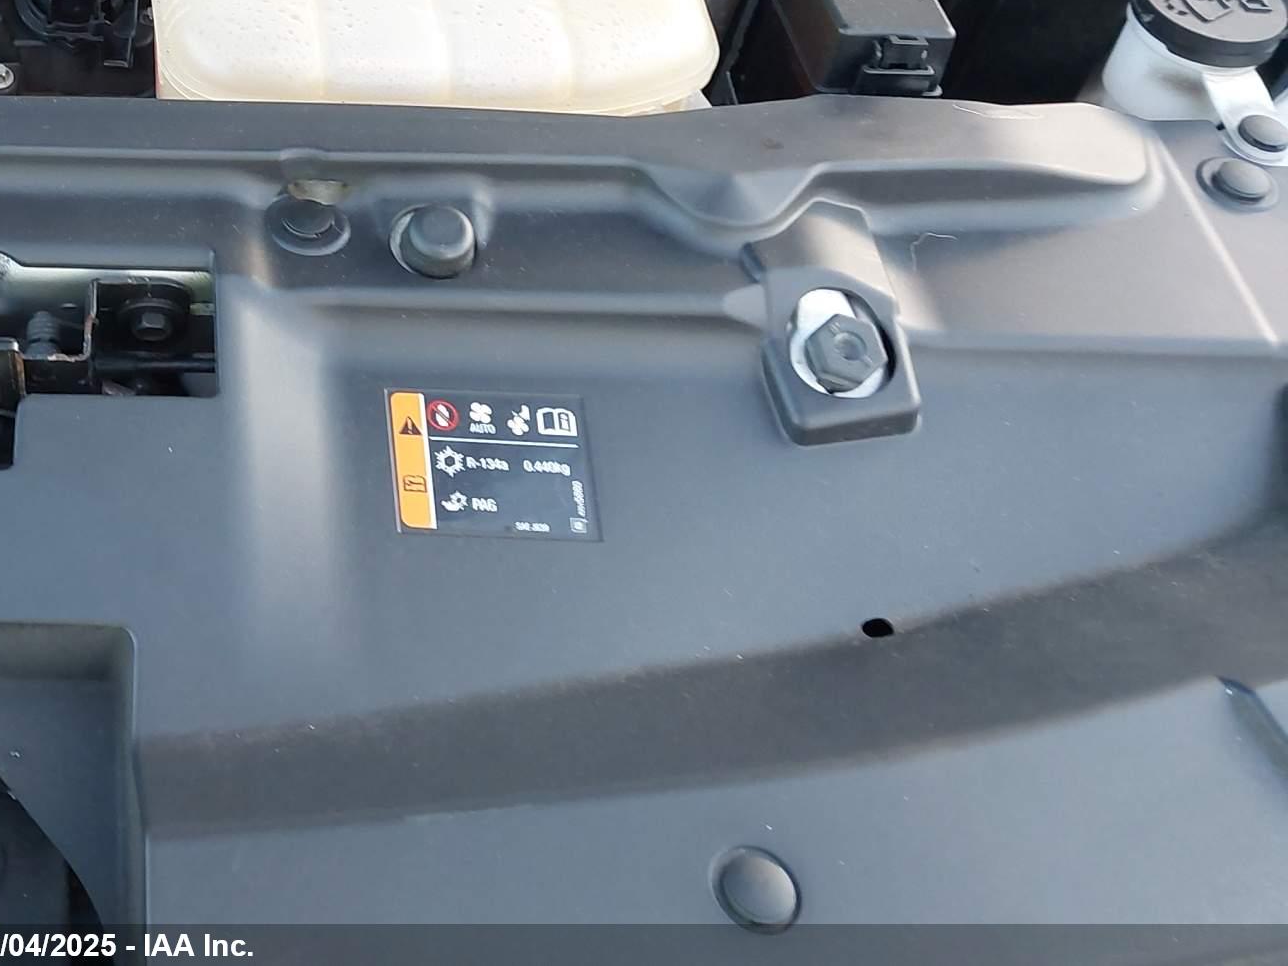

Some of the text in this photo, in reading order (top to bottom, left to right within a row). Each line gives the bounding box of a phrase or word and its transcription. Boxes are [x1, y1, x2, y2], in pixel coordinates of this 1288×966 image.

[469, 423, 496, 434] AUTO
[466, 456, 509, 471] R-134a
[471, 497, 498, 512] PAG
